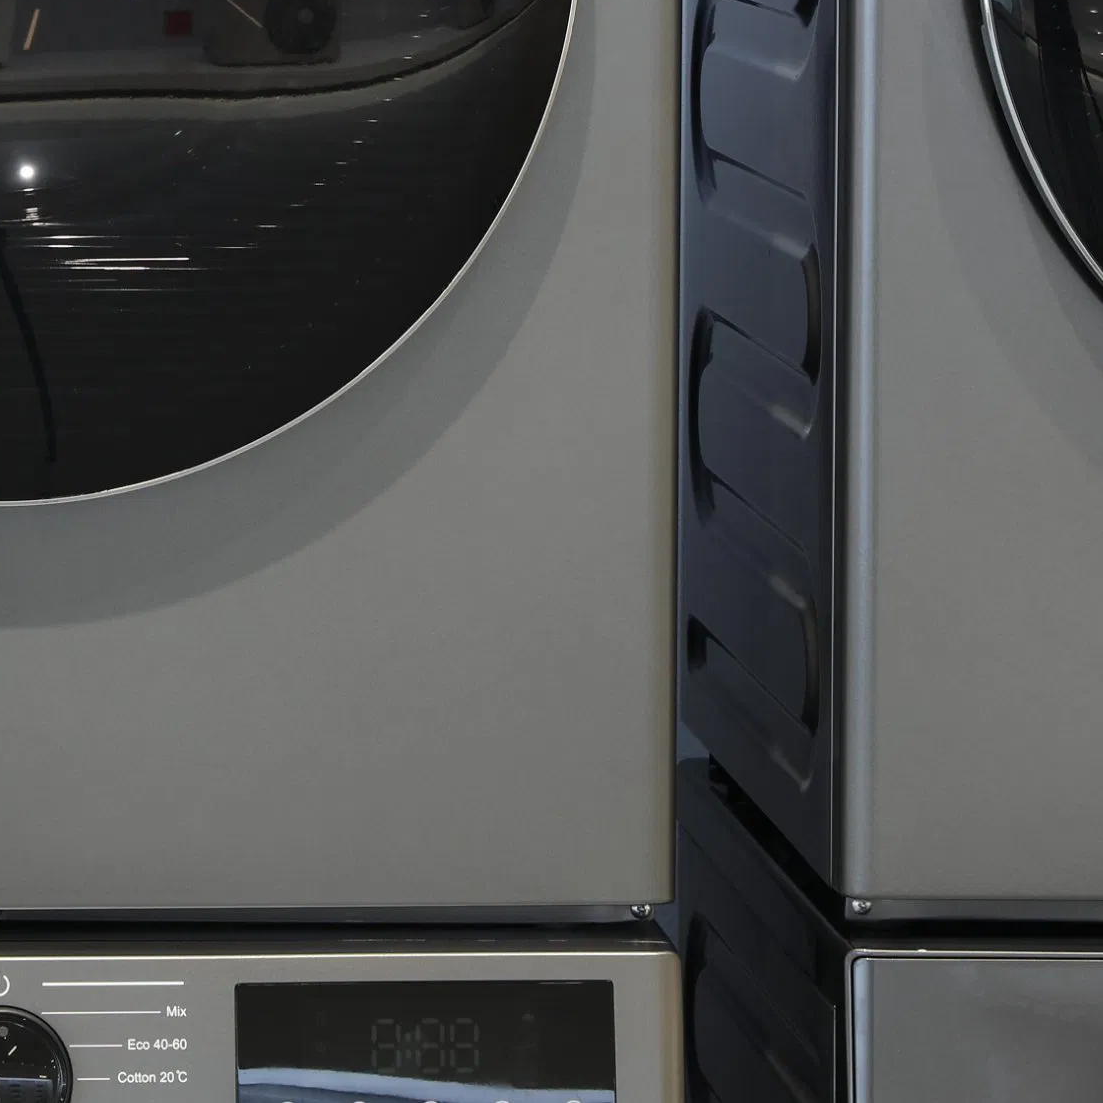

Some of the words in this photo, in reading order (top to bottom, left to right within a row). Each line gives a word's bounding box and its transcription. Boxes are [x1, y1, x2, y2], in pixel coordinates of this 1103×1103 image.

[166, 1006, 187, 1018] Mix
[128, 1039, 150, 1051] Eco
[153, 1038, 188, 1051] 40-60
[118, 1072, 158, 1084] Cotton
